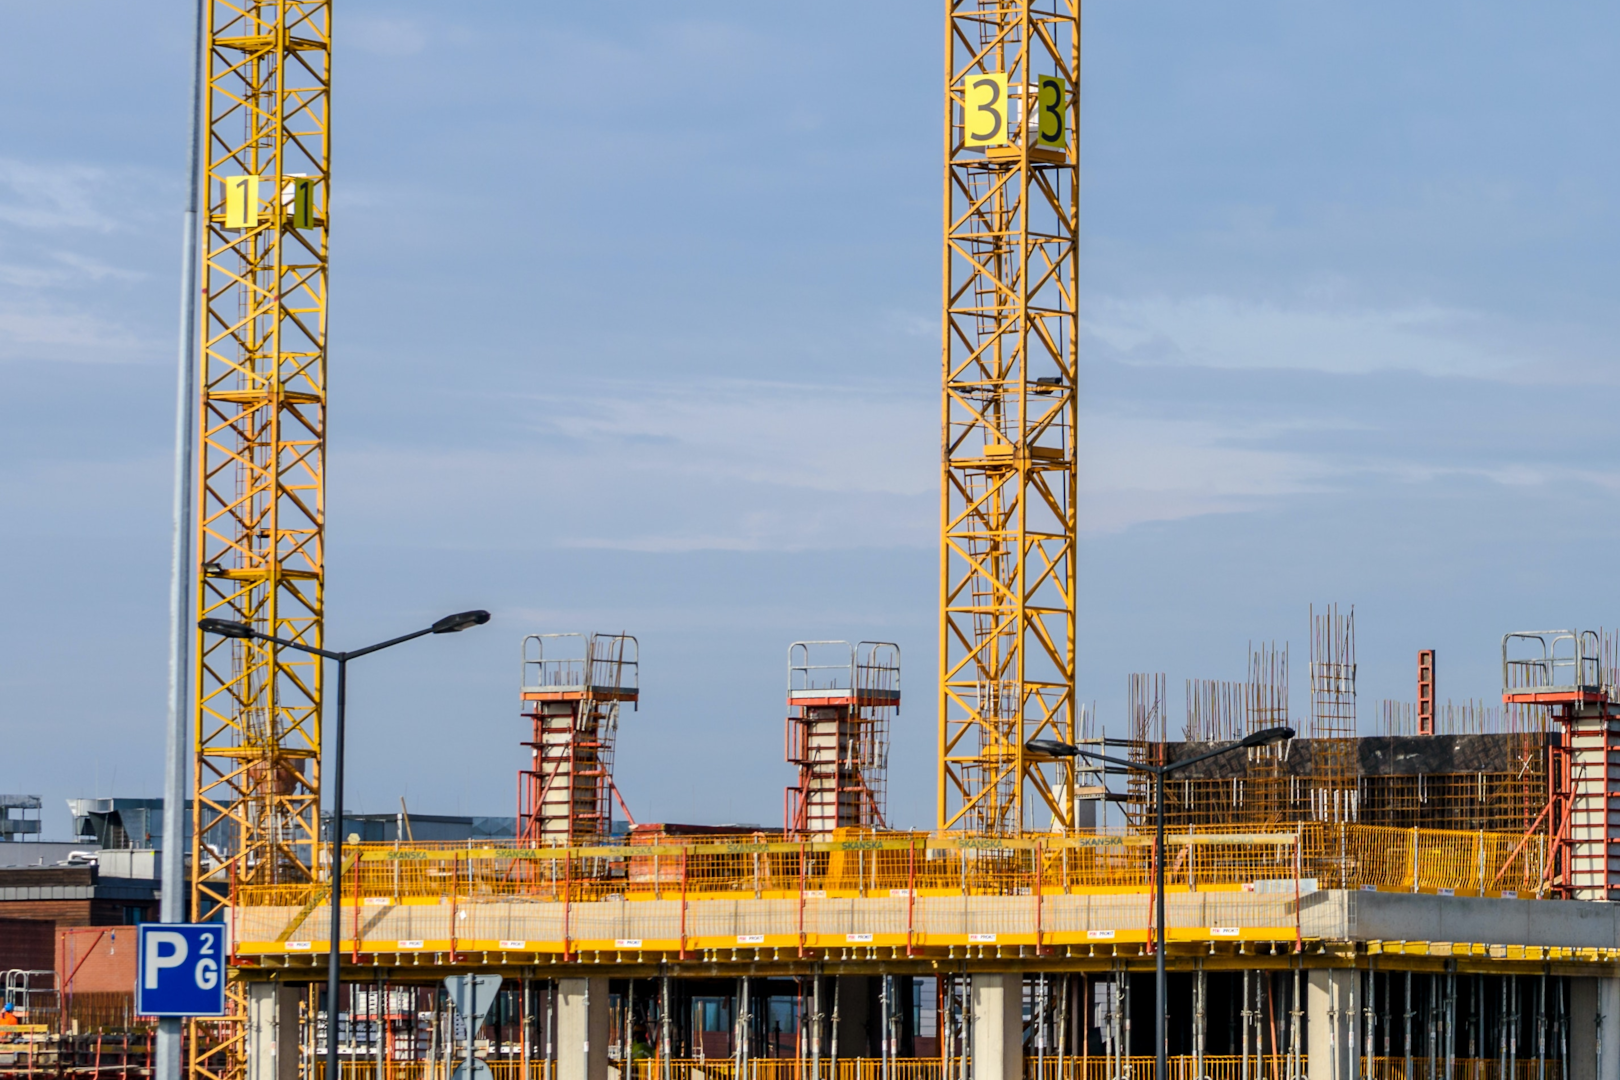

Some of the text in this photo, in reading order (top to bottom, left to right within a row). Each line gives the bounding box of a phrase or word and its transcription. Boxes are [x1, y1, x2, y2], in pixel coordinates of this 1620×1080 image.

[970, 78, 1002, 141] 3
[1041, 80, 1062, 142] 3
[236, 179, 249, 224] 1
[300, 181, 309, 226] 1
[727, 843, 770, 852] SKANSKA
[842, 841, 883, 850] SKANSKA
[958, 839, 1003, 848] SKANSKA
[1079, 837, 1123, 846] SKANSKA
[387, 851, 427, 860] SKANSKA
[495, 849, 536, 858] SKANSKA
[199, 932, 214, 955] 2
[144, 931, 188, 989] P
[194, 958, 218, 990] G
